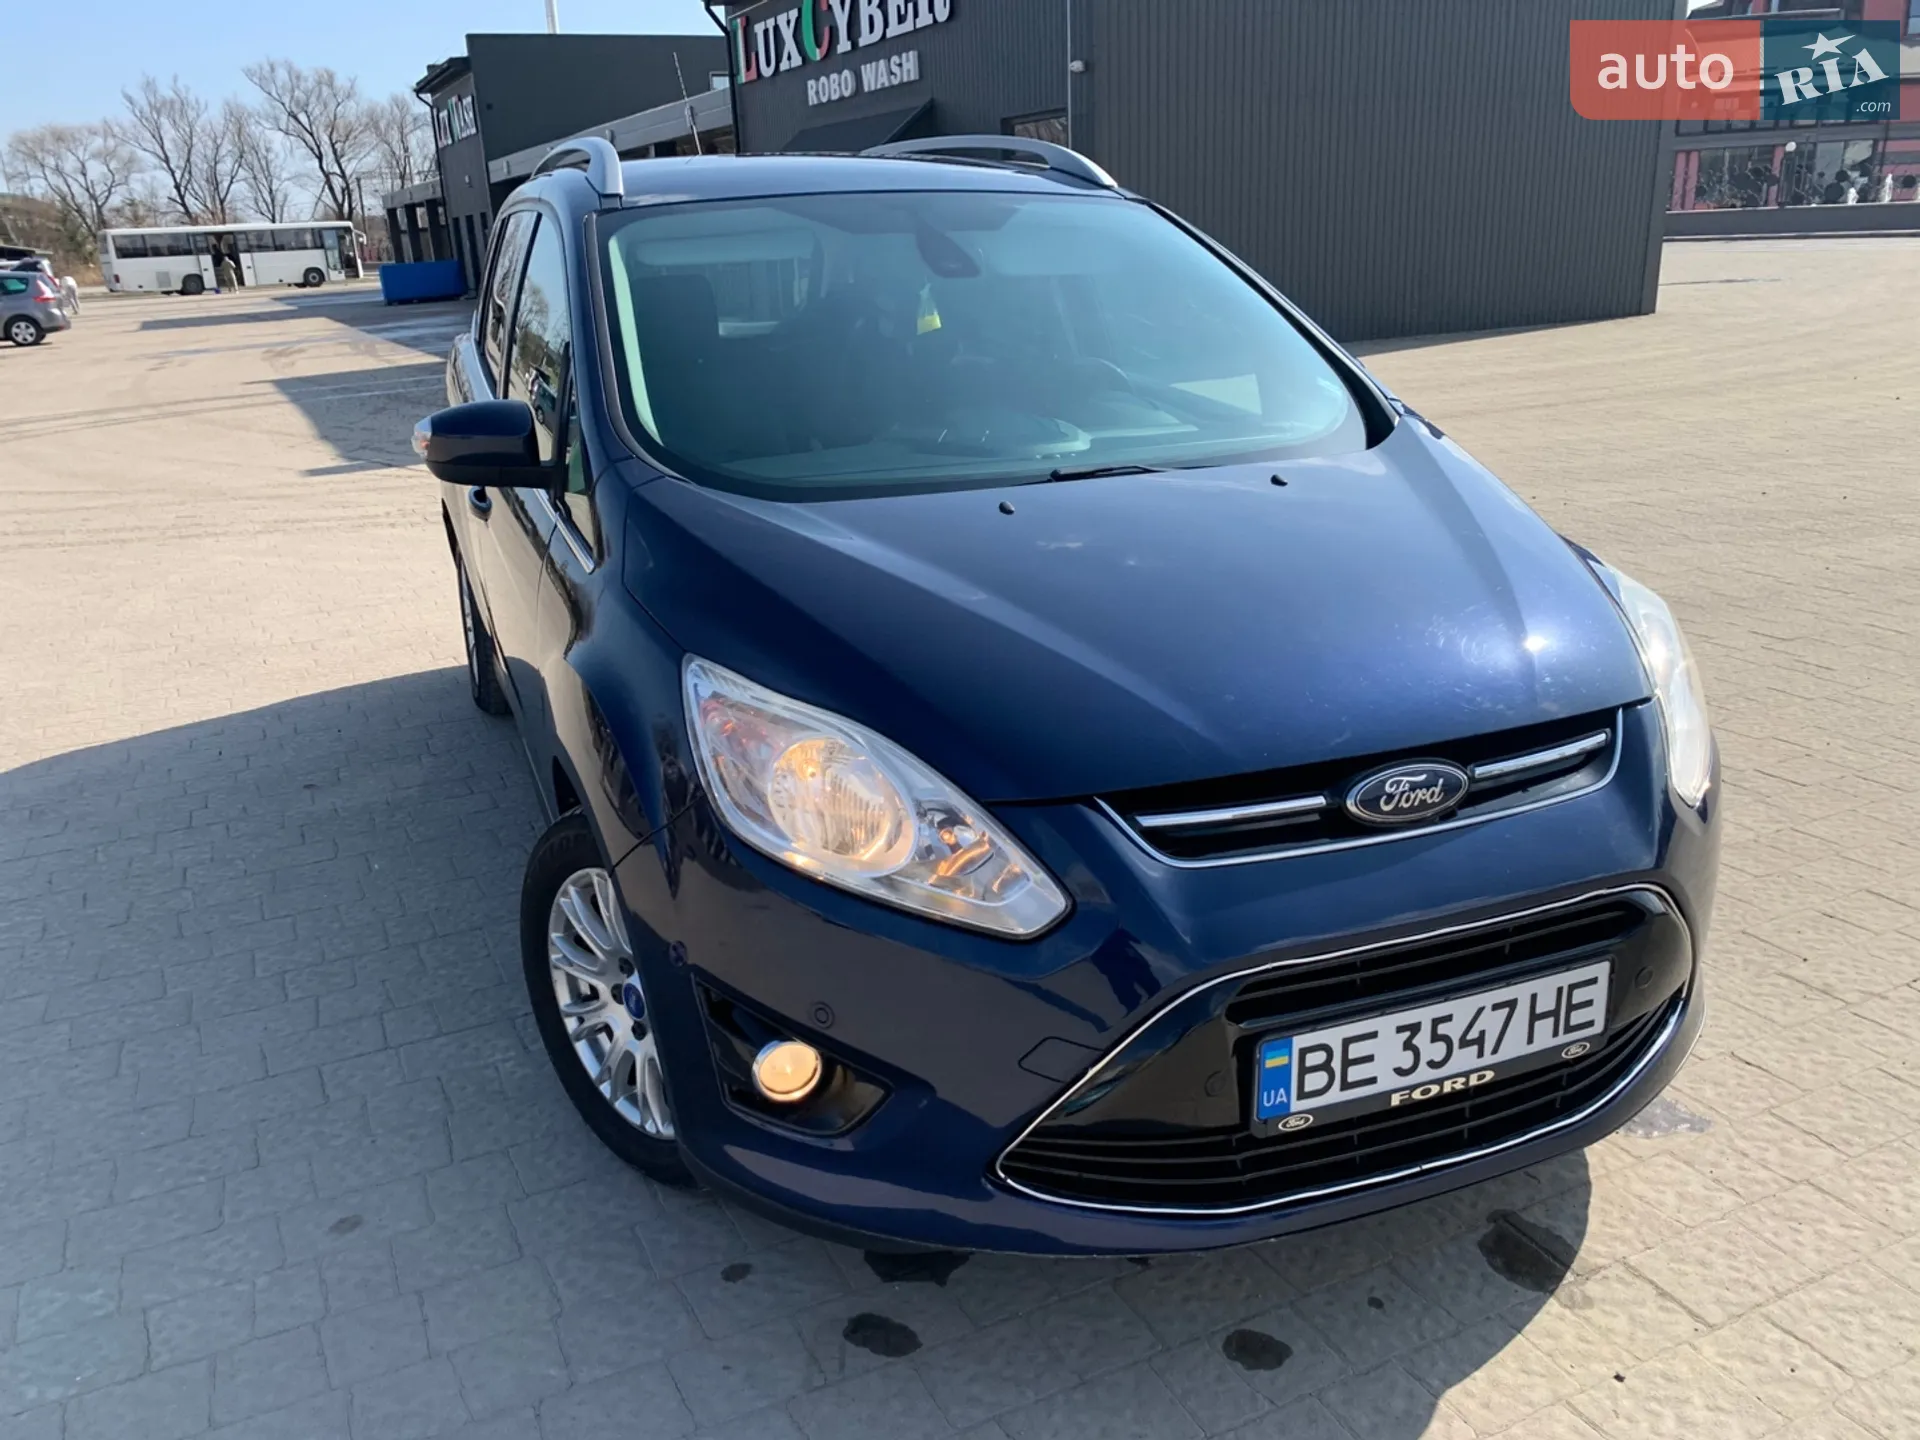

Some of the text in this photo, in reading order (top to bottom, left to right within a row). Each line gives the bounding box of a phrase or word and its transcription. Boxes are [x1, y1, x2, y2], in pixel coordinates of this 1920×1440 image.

[806, 50, 920, 107] ROBO WASH
[1379, 773, 1444, 811] Ford
[1296, 977, 1599, 1101] BE 3547 HE
[1263, 1087, 1288, 1107] UA
[1390, 1070, 1495, 1107] FORD
